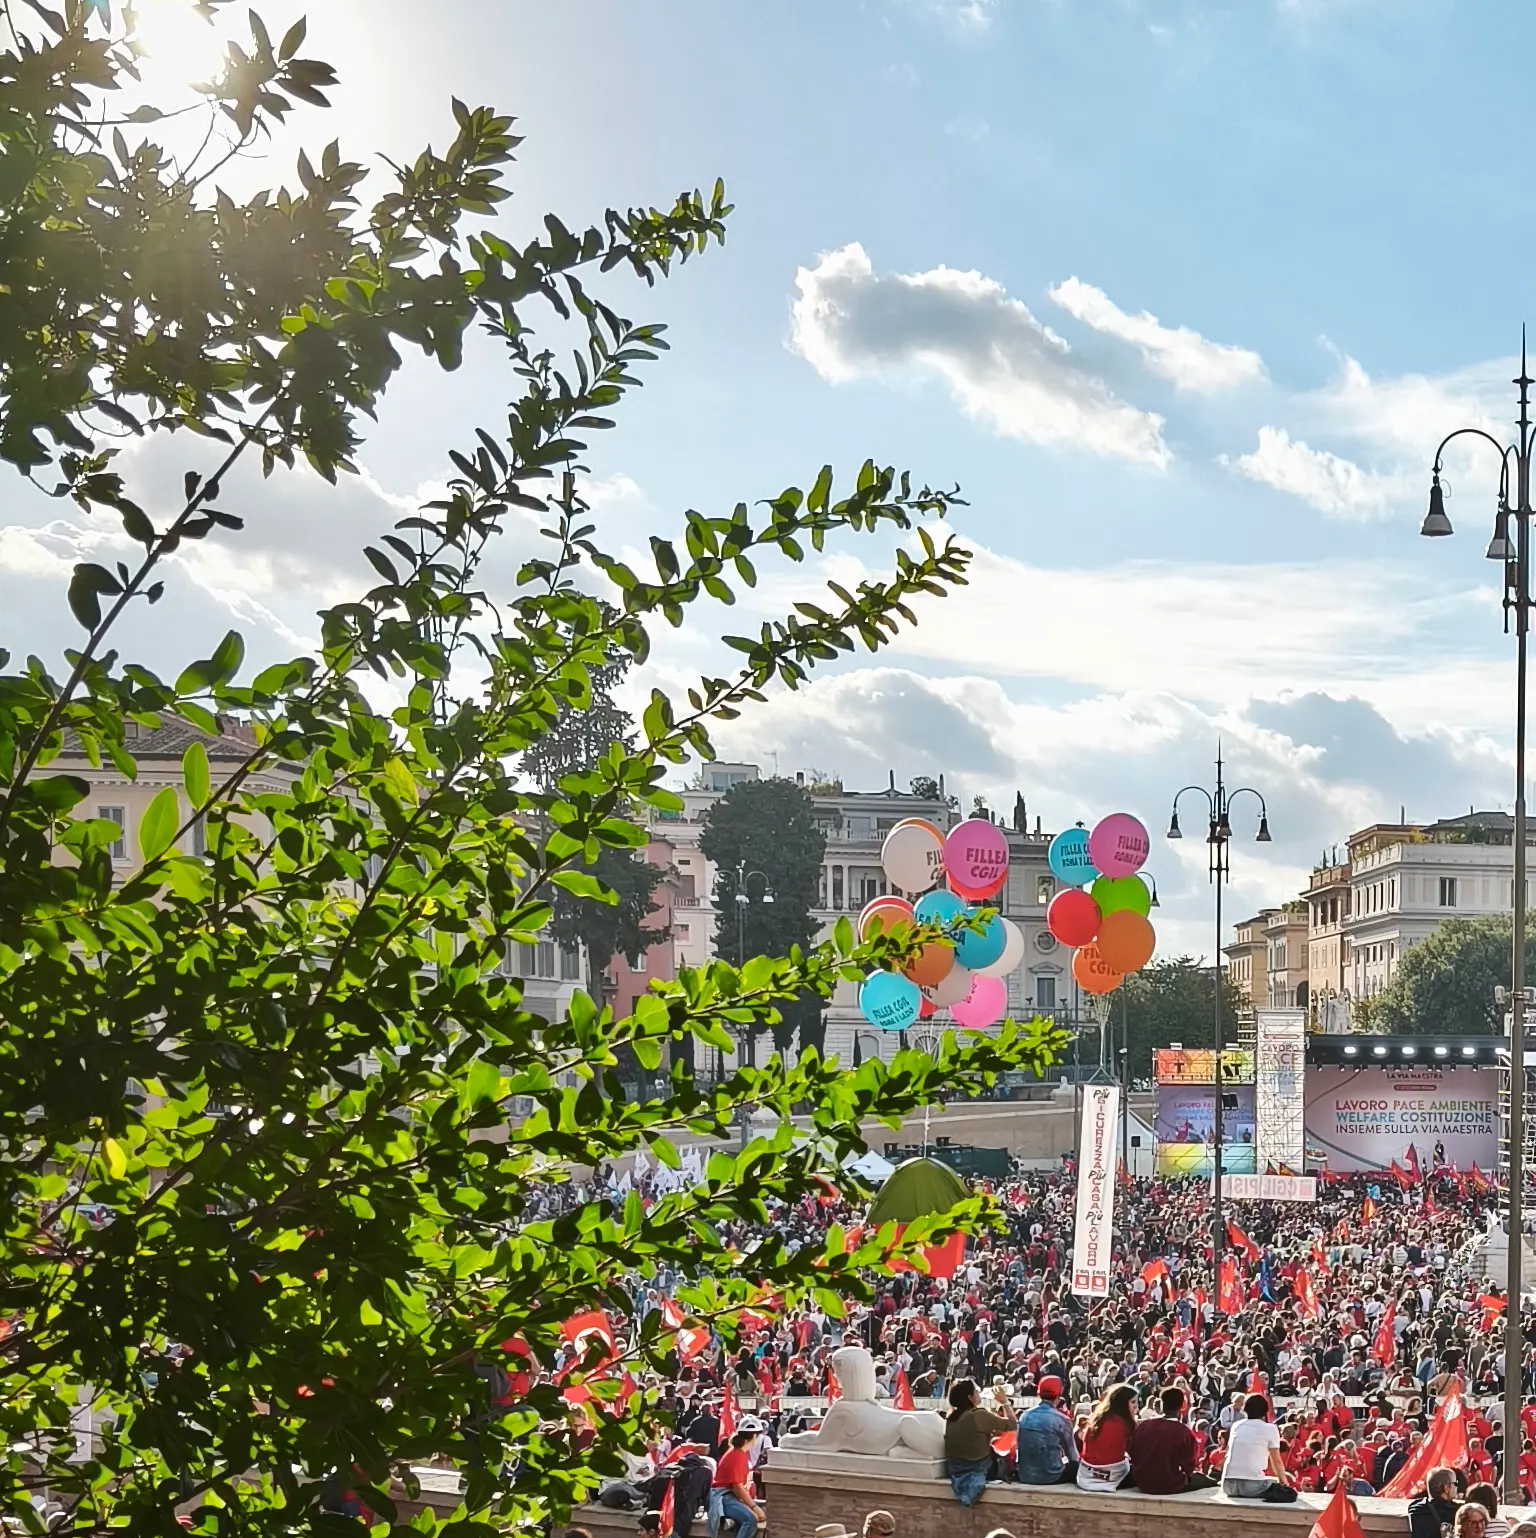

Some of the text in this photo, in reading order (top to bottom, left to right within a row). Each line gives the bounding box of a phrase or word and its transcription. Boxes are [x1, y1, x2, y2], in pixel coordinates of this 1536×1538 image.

[966, 848, 1006, 864] FILLEA
[970, 866, 999, 879] CGIL
[1335, 1100, 1492, 1112] LAVORO PACE AMBIENTE
[1335, 1112, 1492, 1123] WELFARE COSTITUZIONE
[1336, 1124, 1492, 1134] INSIEME SULLA VIA MAESTRA
